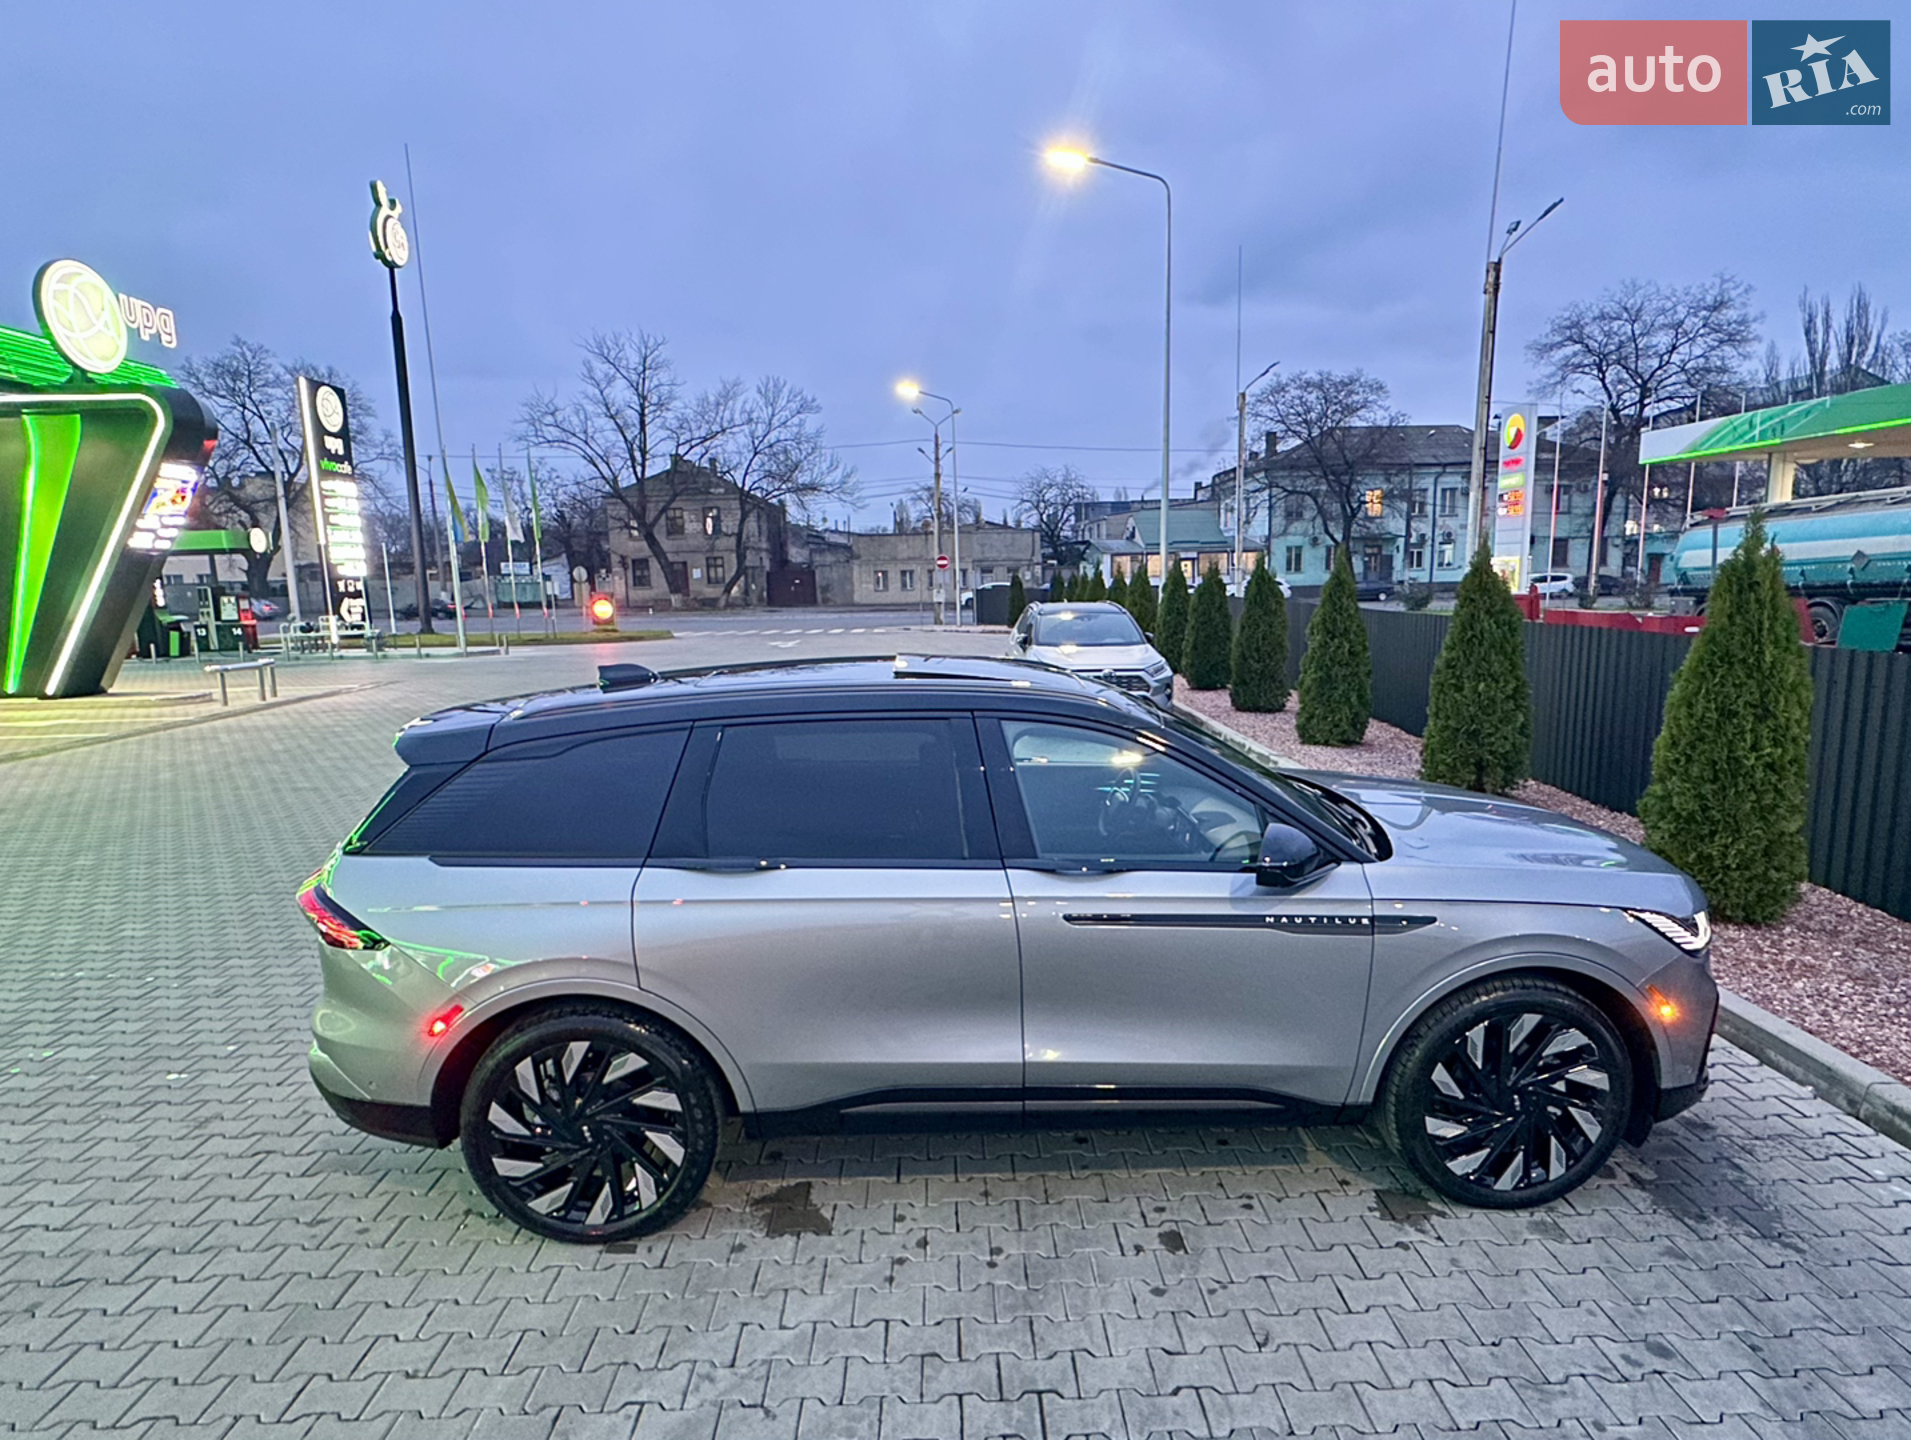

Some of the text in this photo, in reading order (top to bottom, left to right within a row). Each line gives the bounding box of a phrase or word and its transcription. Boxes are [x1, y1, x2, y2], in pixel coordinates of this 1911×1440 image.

[118, 292, 178, 349] upg
[196, 627, 207, 636] 13
[231, 627, 243, 636] 14
[1265, 916, 1370, 924] NAUTILUS
